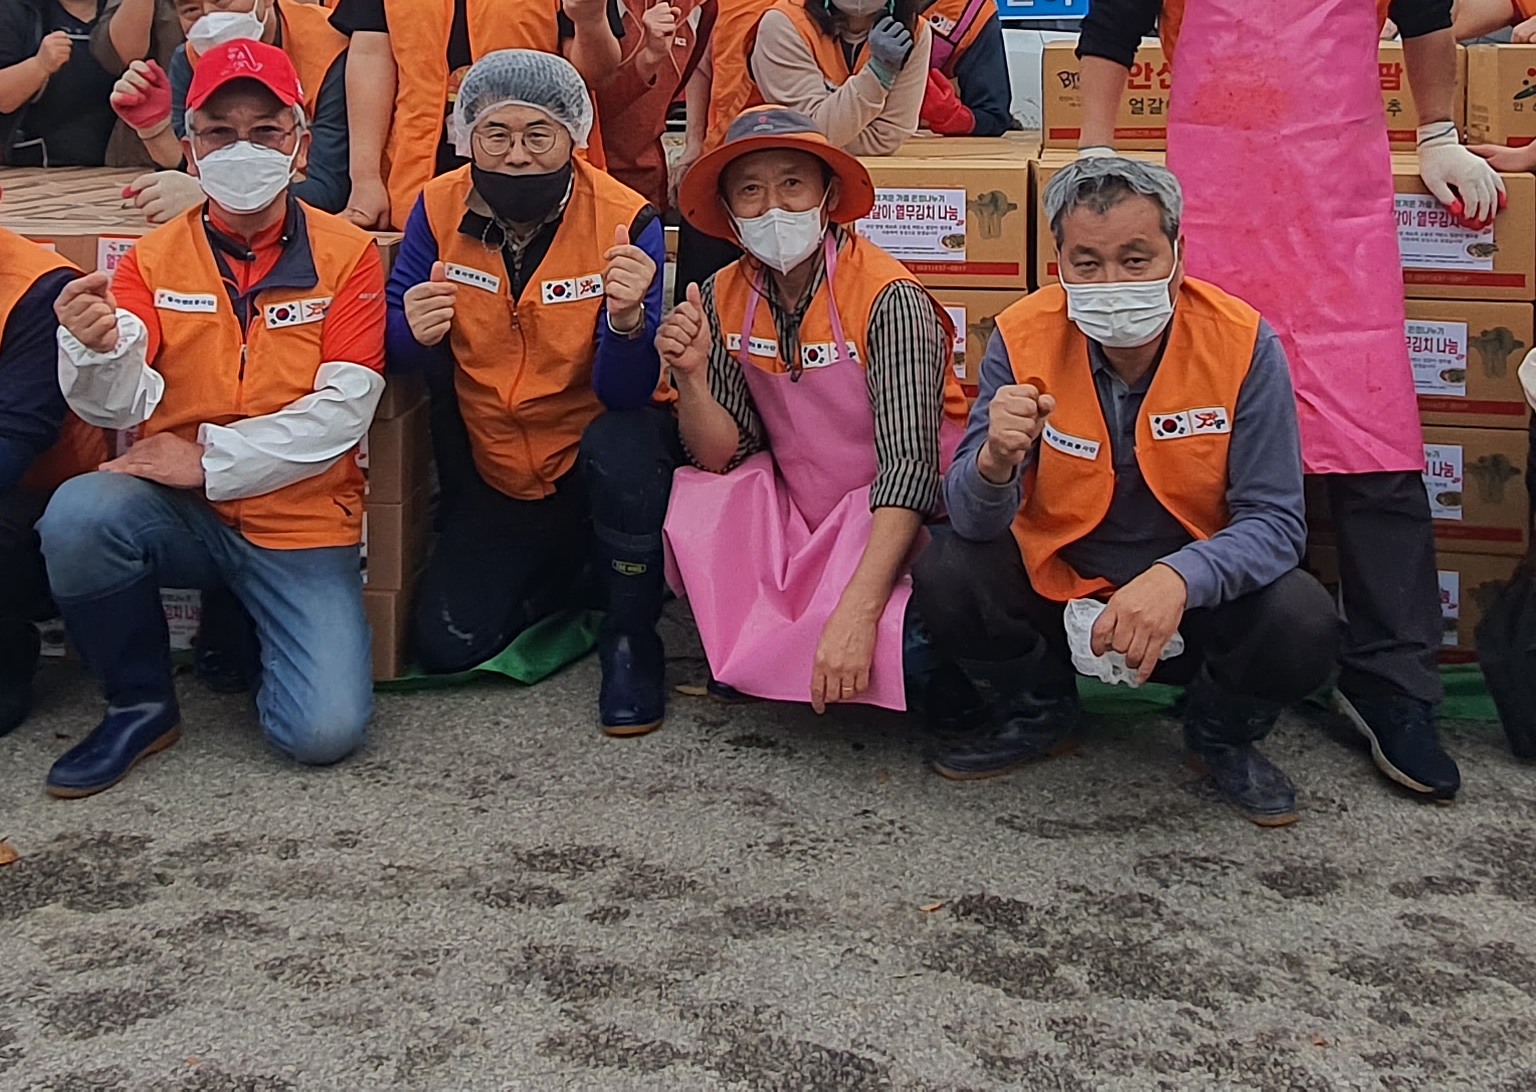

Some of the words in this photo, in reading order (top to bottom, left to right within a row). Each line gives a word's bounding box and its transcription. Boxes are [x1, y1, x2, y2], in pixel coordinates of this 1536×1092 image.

[938, 204, 959, 221] 나눔
[1436, 337, 1459, 355] 나눔
[1432, 460, 1454, 478] 나눔
